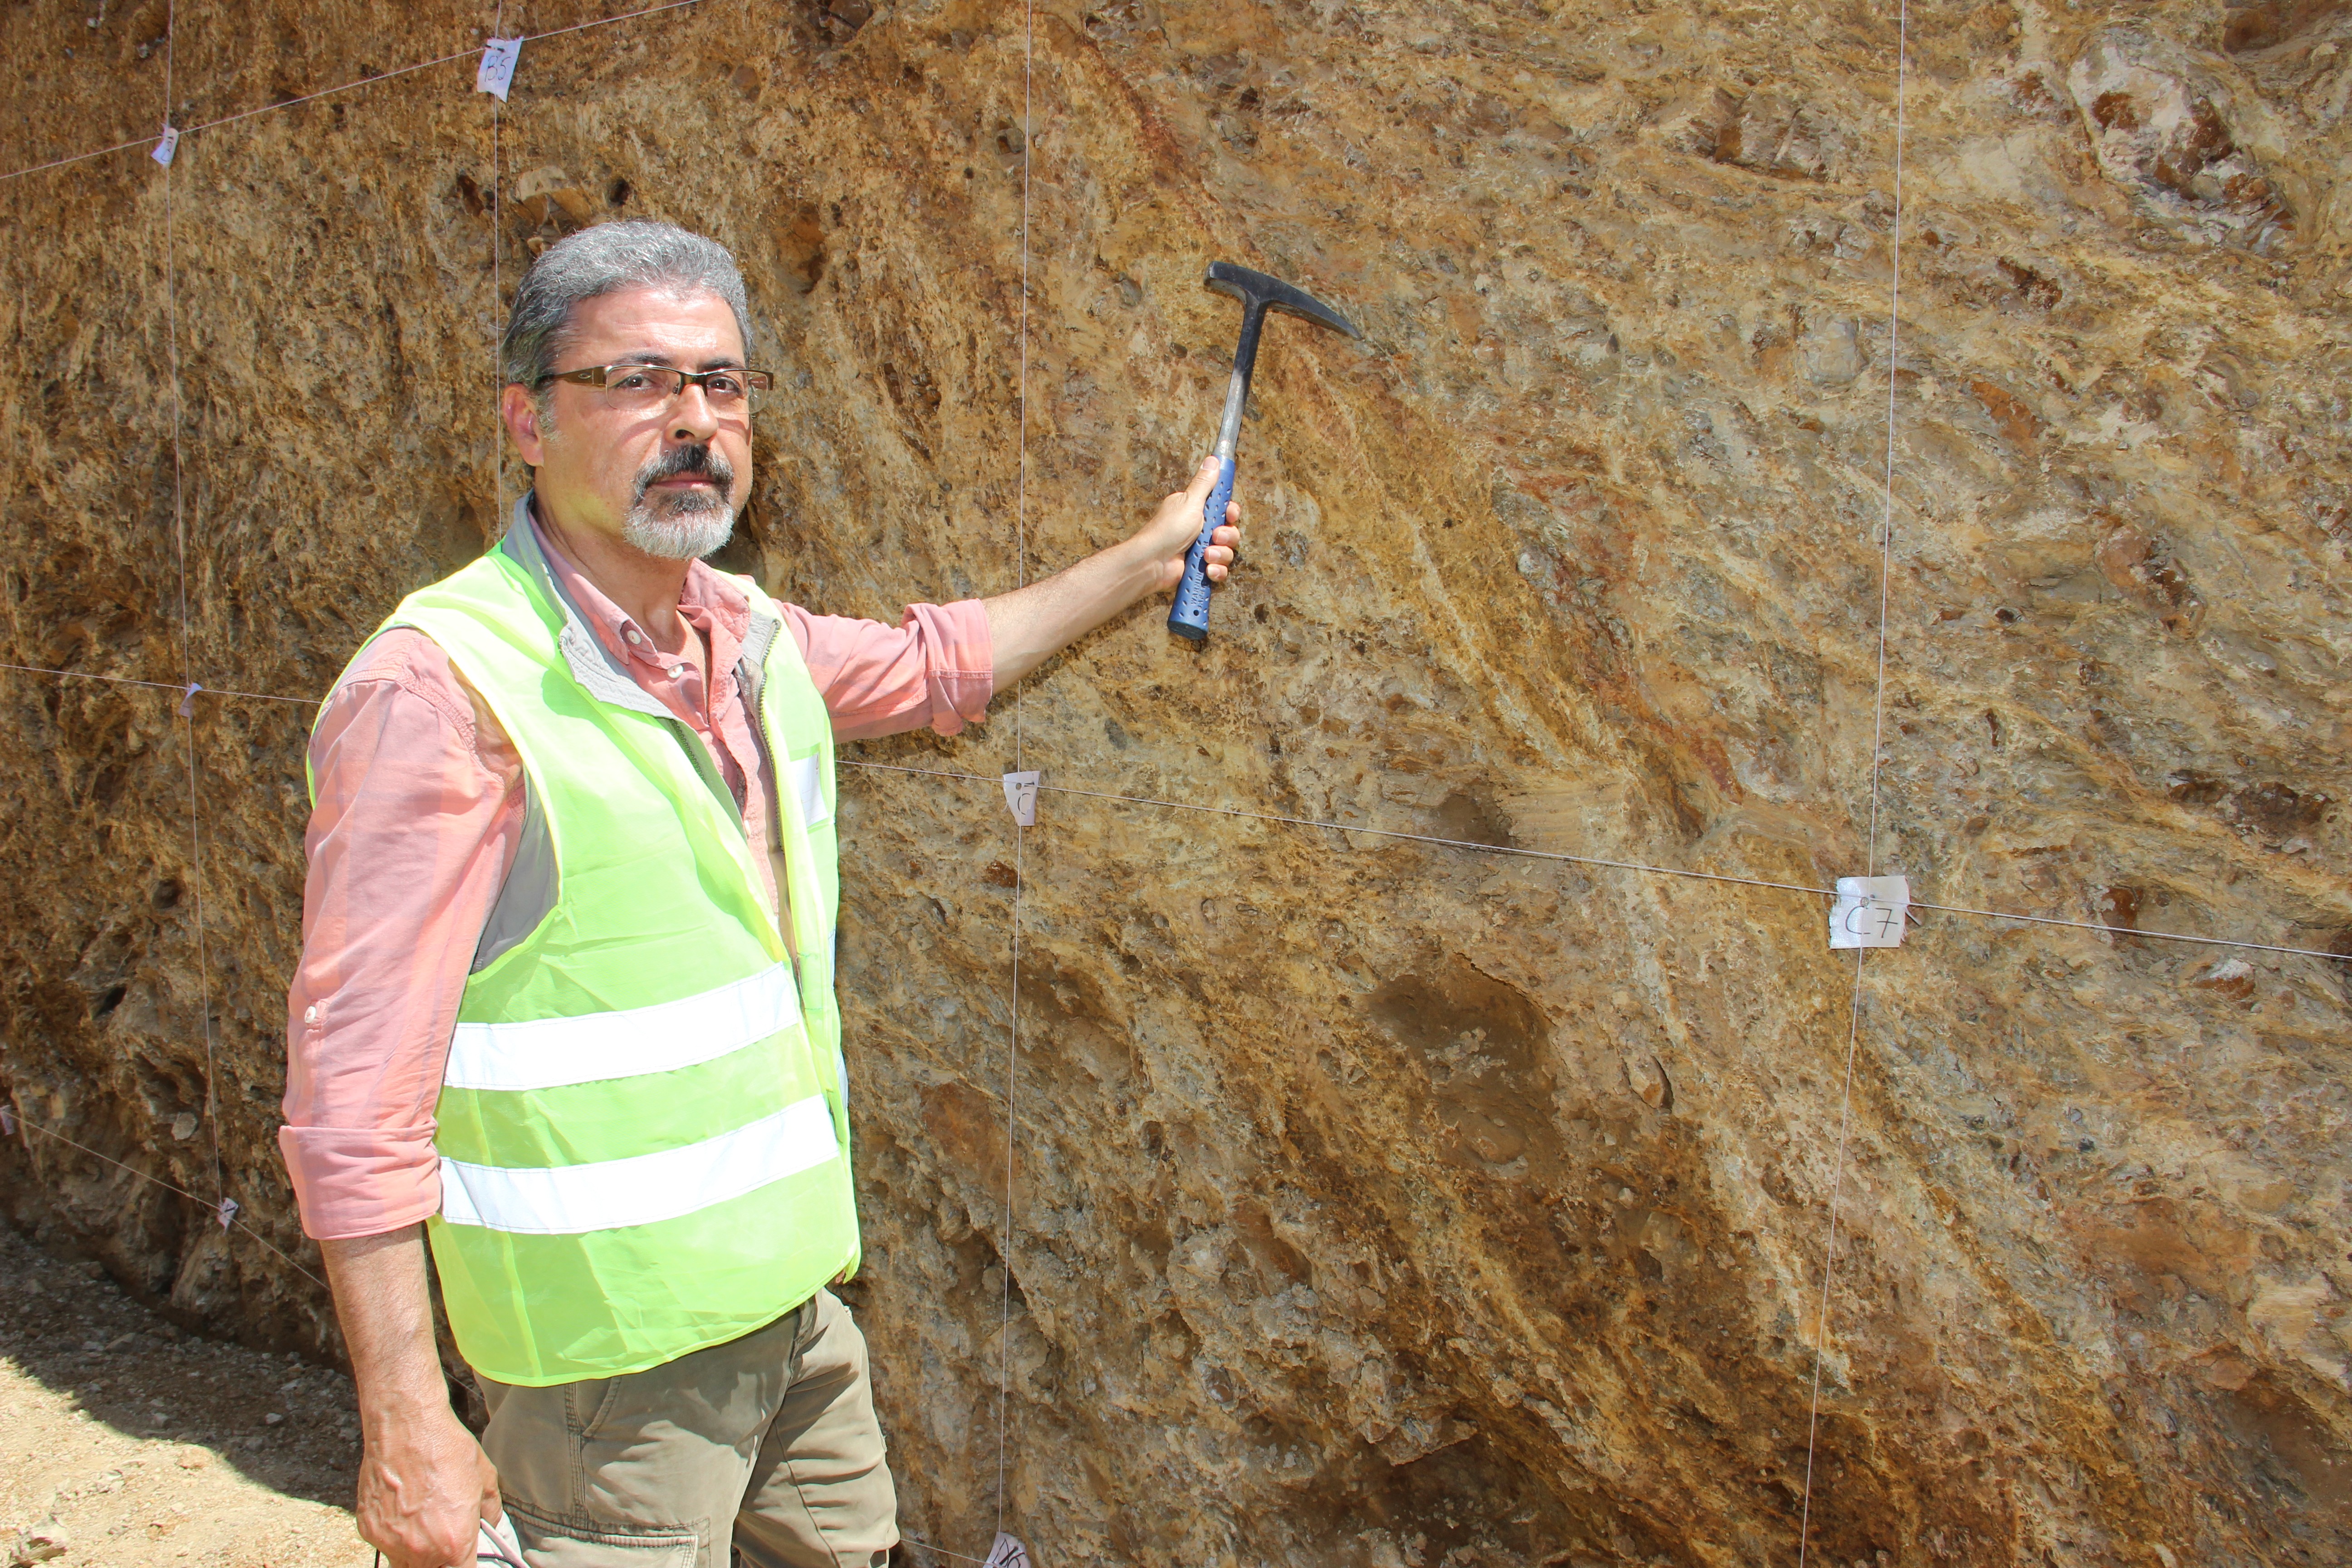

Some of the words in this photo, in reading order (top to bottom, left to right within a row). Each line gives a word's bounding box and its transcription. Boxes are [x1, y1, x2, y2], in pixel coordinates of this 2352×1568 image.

[484, 55, 511, 82] B5
[1191, 572, 1204, 605] WARNIN
[1197, 585, 1205, 611] SAFET
[1846, 905, 1898, 938] C7
